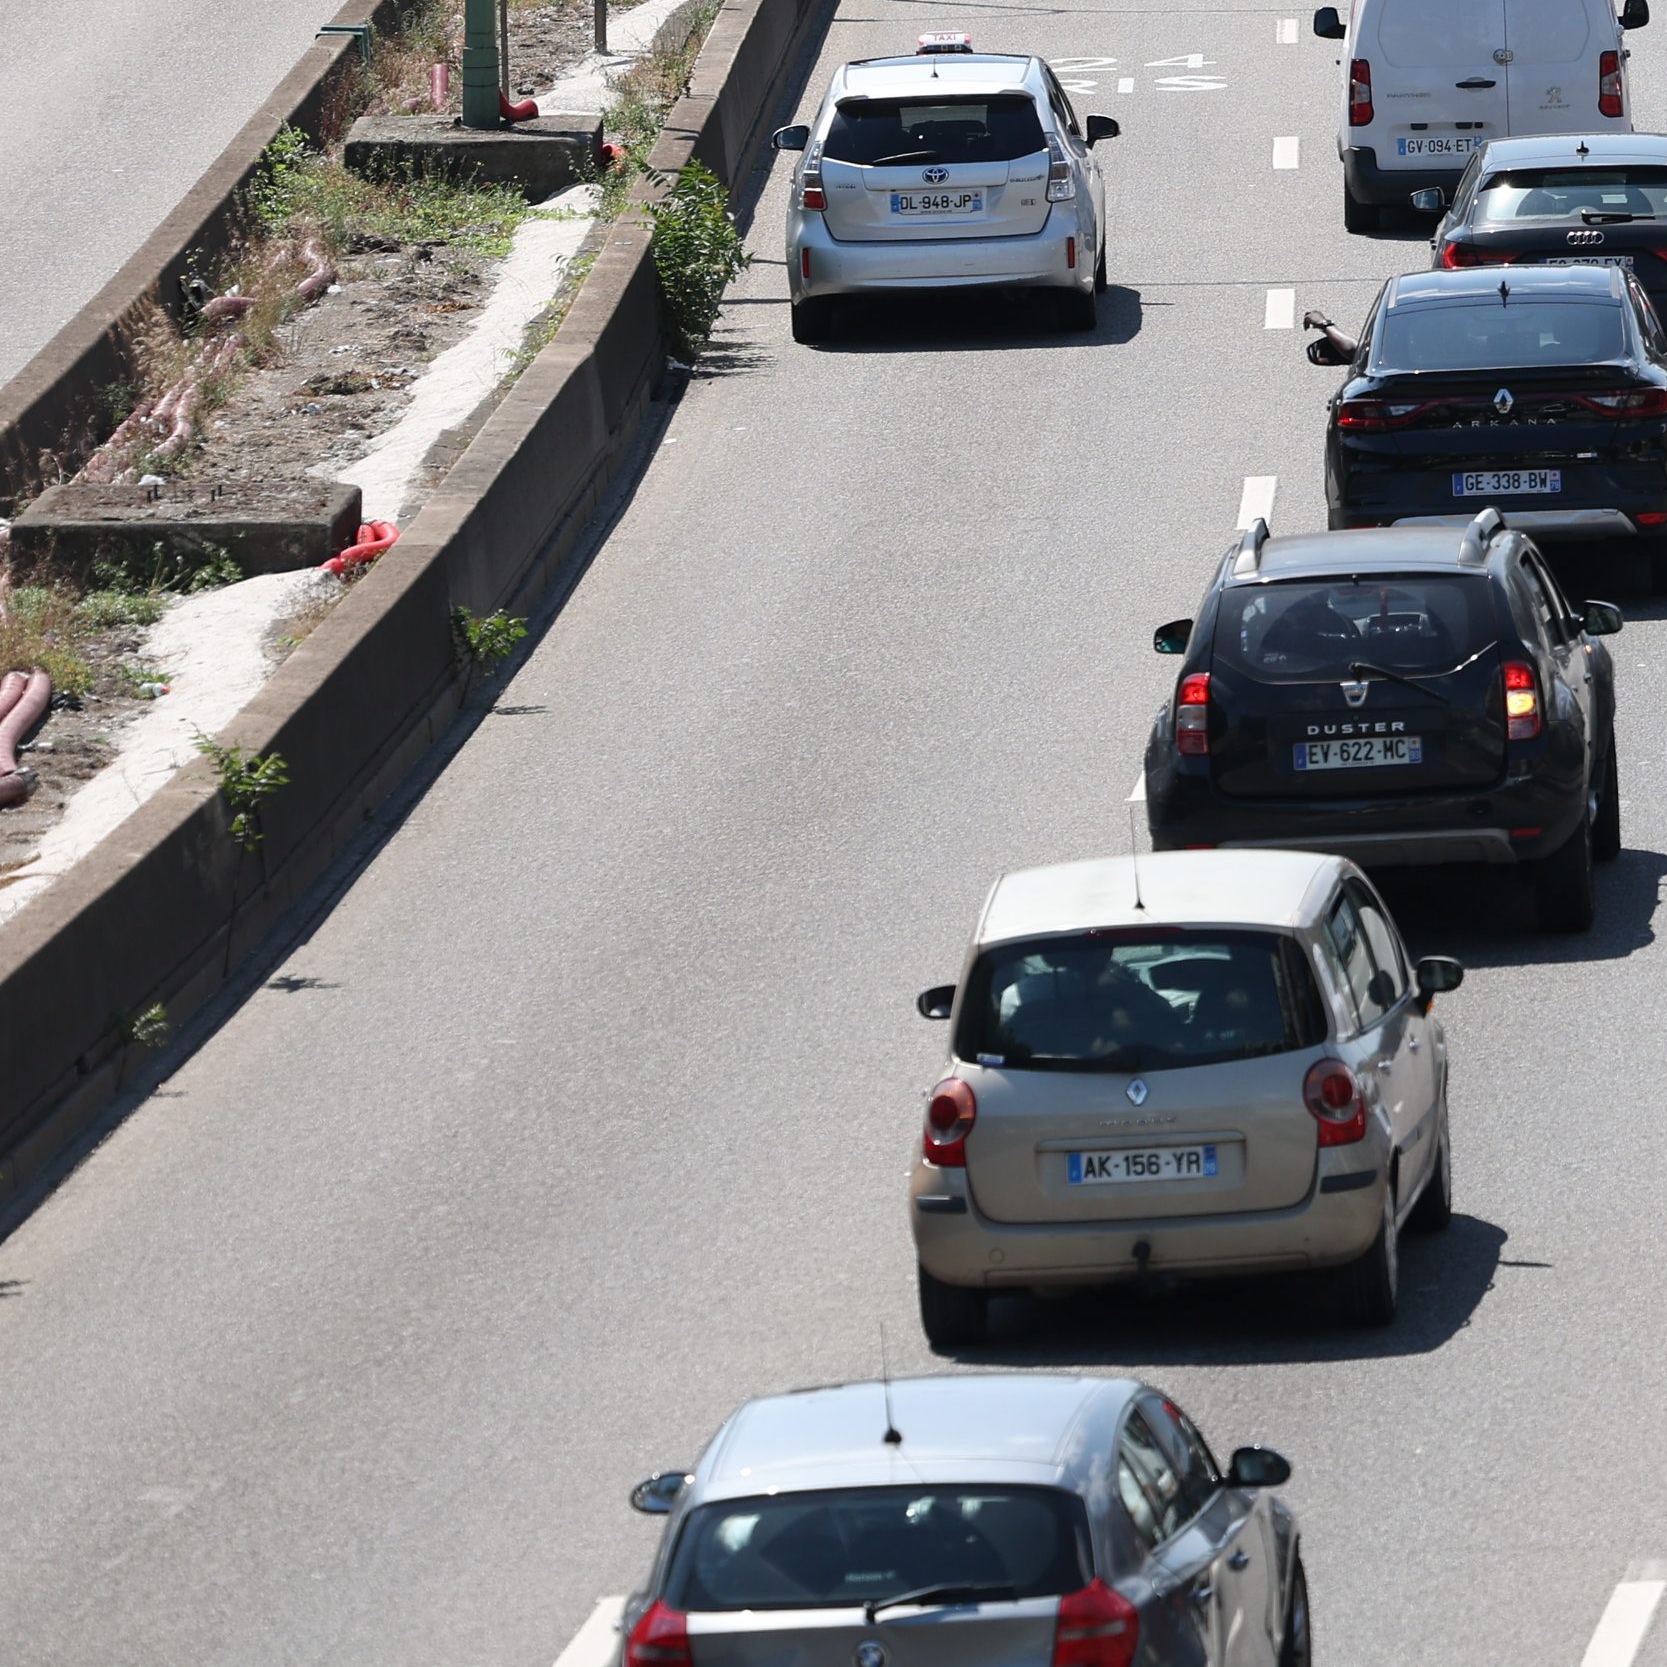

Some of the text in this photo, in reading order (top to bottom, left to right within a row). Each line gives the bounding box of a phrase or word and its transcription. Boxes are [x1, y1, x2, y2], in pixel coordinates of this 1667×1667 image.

[934, 33, 957, 42] TAXI
[1048, 53, 1217, 73] 24
[1060, 76, 1229, 95] RIS
[1407, 138, 1472, 154] GV-094-ET
[900, 194, 972, 211] DL-948-JP
[1452, 417, 1557, 429] ARKANA
[1464, 470, 1549, 491] GE-338-BW
[1306, 721, 1405, 735] DUSTER
[1308, 739, 1407, 765] EV-622-MC
[1083, 1145, 1202, 1179] AK-156-YR
